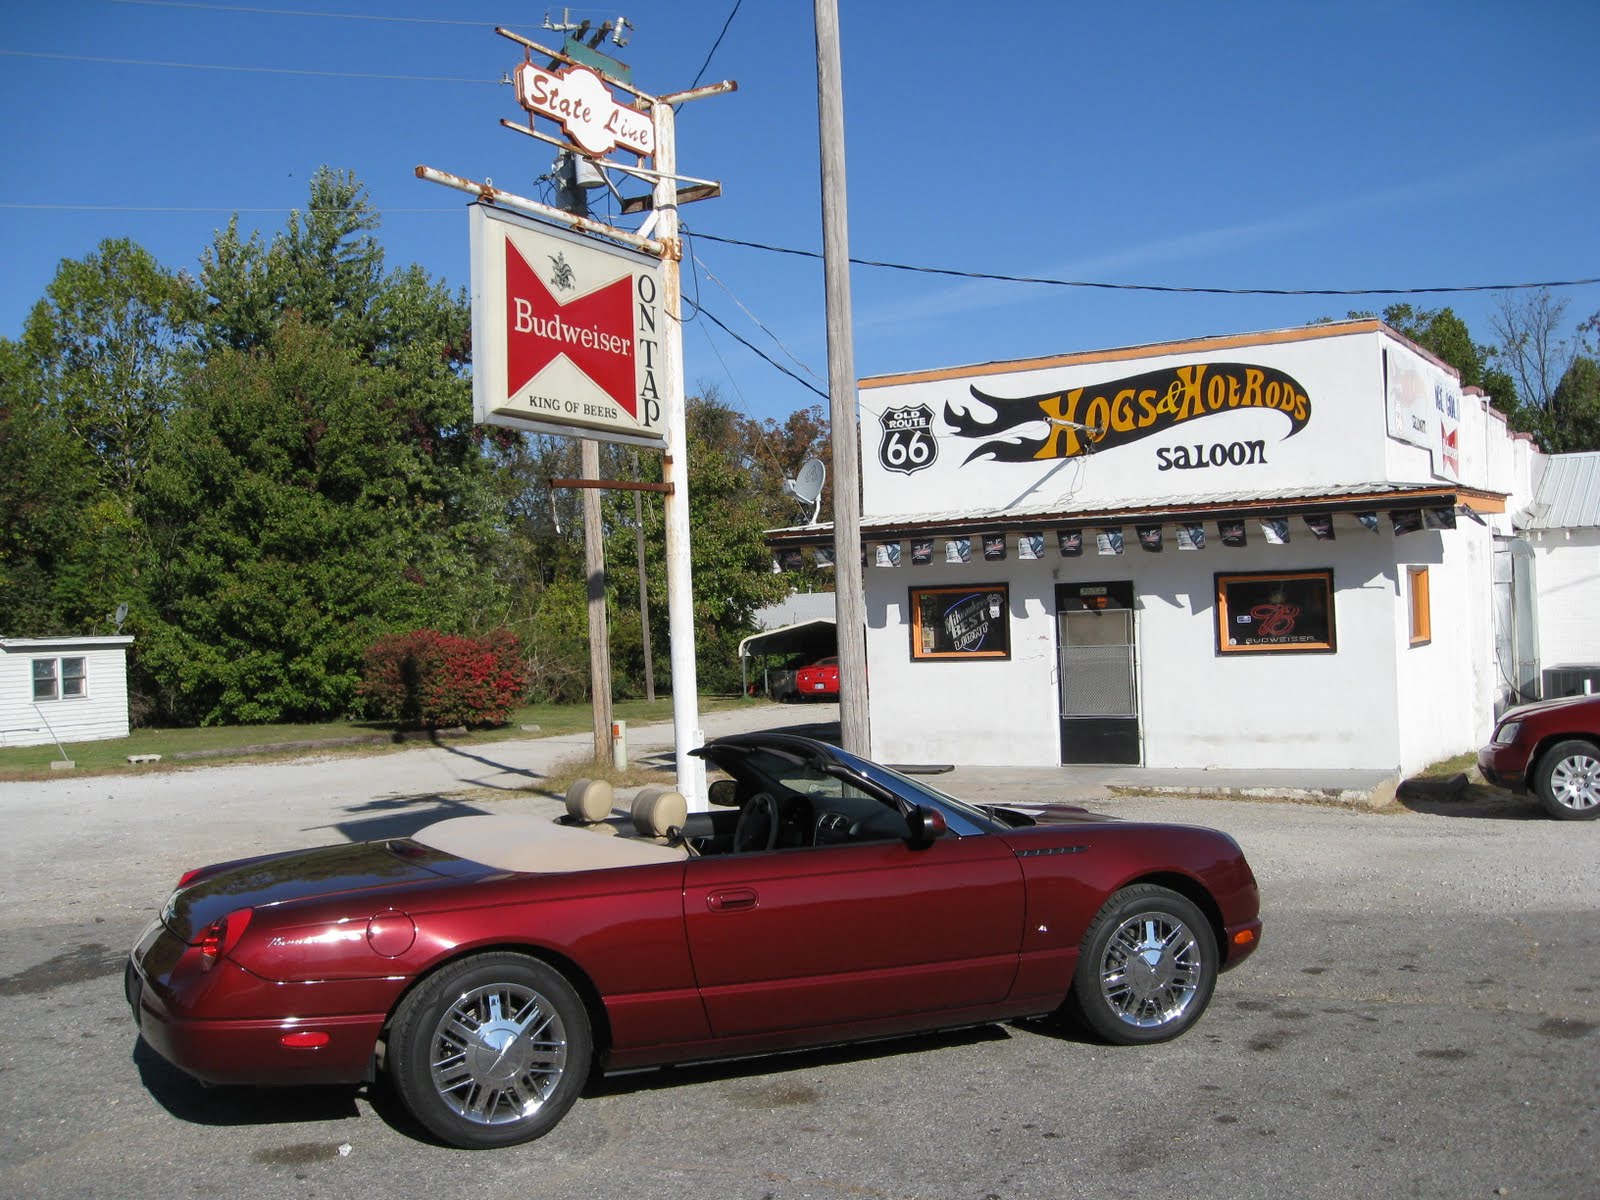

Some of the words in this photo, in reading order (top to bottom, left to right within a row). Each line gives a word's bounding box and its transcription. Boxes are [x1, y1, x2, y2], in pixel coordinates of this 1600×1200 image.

[531, 74, 592, 123] State
[603, 108, 649, 146] Line
[513, 297, 631, 357] Budweiser
[637, 274, 656, 334] ON
[529, 395, 561, 411] KING
[564, 400, 580, 414] OF
[583, 402, 618, 419] BEERS
[639, 338, 661, 428] TAP
[889, 417, 926, 429] ROUTE
[893, 411, 921, 420] OLD
[1033, 387, 1157, 460] HOGS
[887, 430, 930, 466] 66
